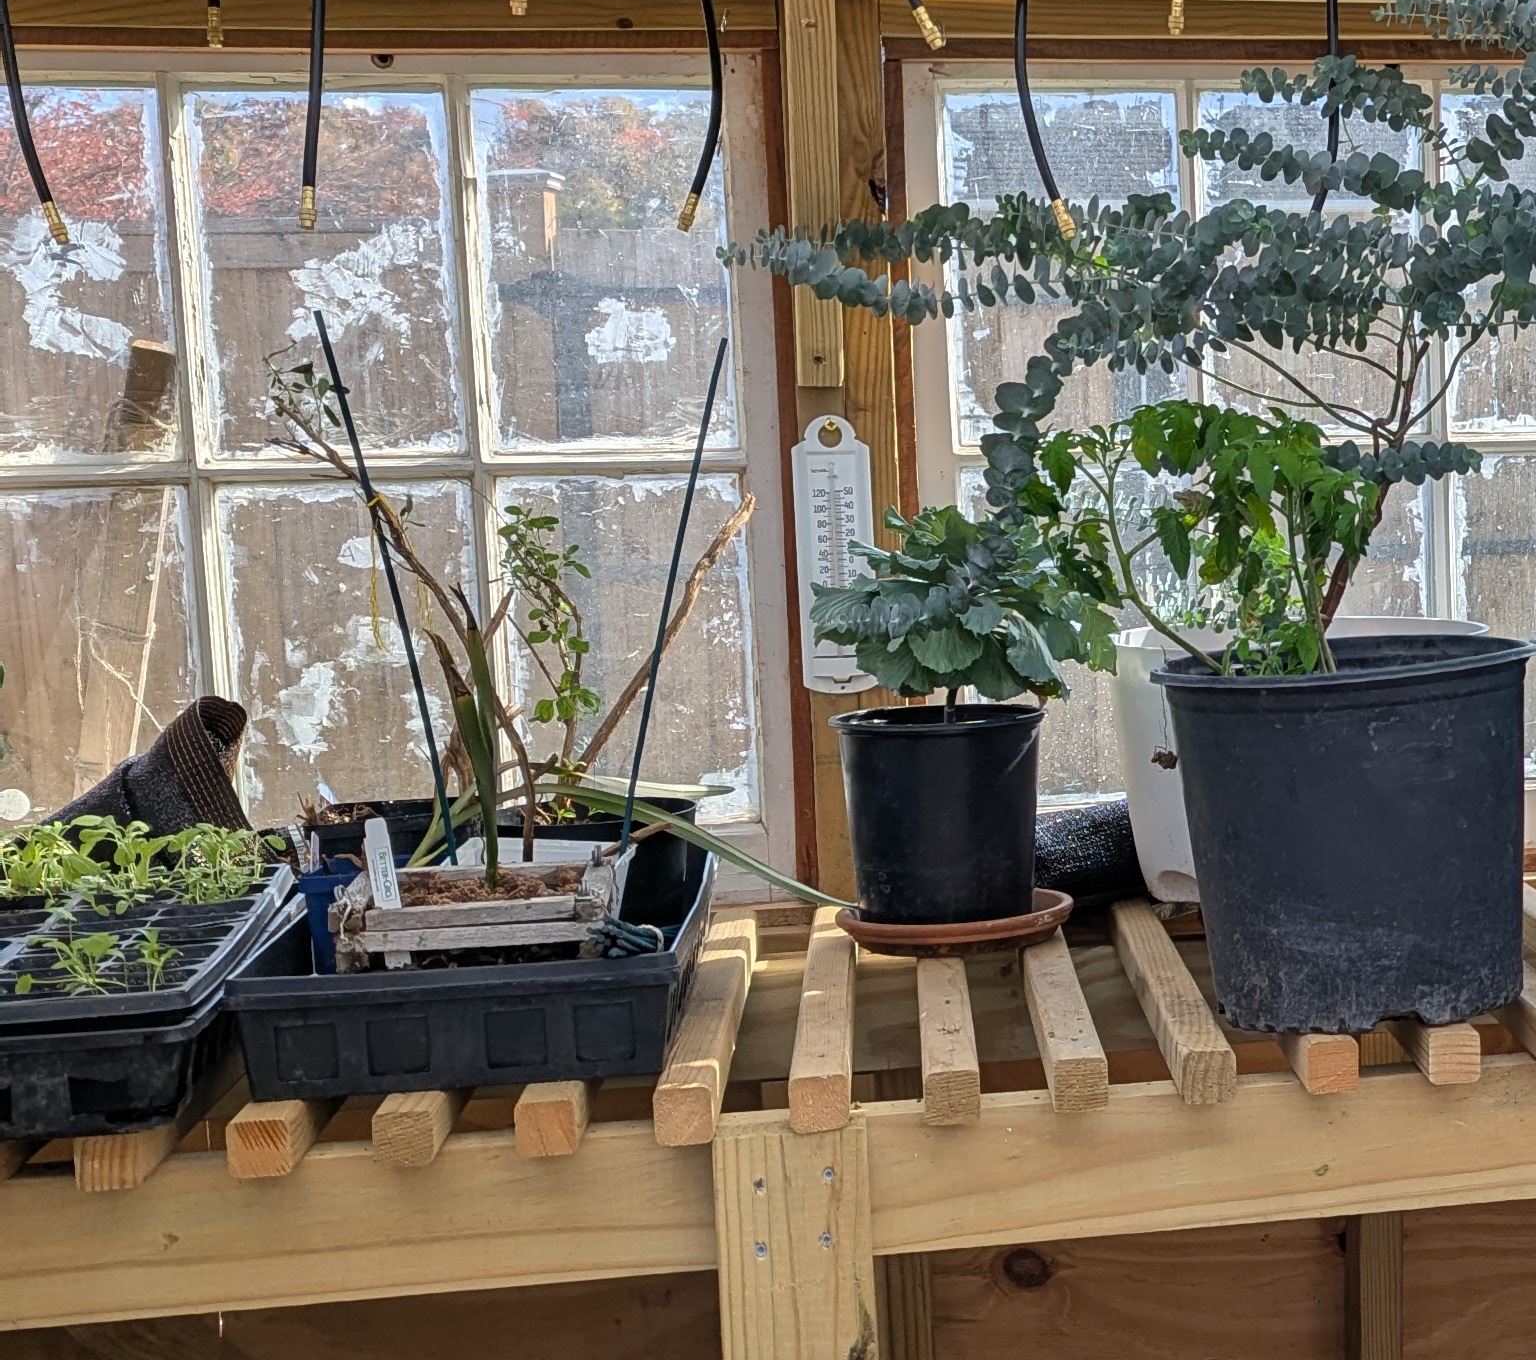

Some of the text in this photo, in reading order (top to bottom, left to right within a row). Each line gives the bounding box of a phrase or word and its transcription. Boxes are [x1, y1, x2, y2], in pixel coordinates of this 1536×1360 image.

[812, 489, 825, 497] 120
[843, 487, 853, 495] 50
[814, 505, 826, 513] 100
[844, 501, 853, 509] 40
[845, 515, 854, 523] 30
[817, 520, 827, 528] 80
[846, 528, 855, 536] 20
[818, 535, 828, 543] 60
[849, 555, 854, 563] 0
[819, 566, 829, 574] 20
[848, 569, 856, 577] 10
